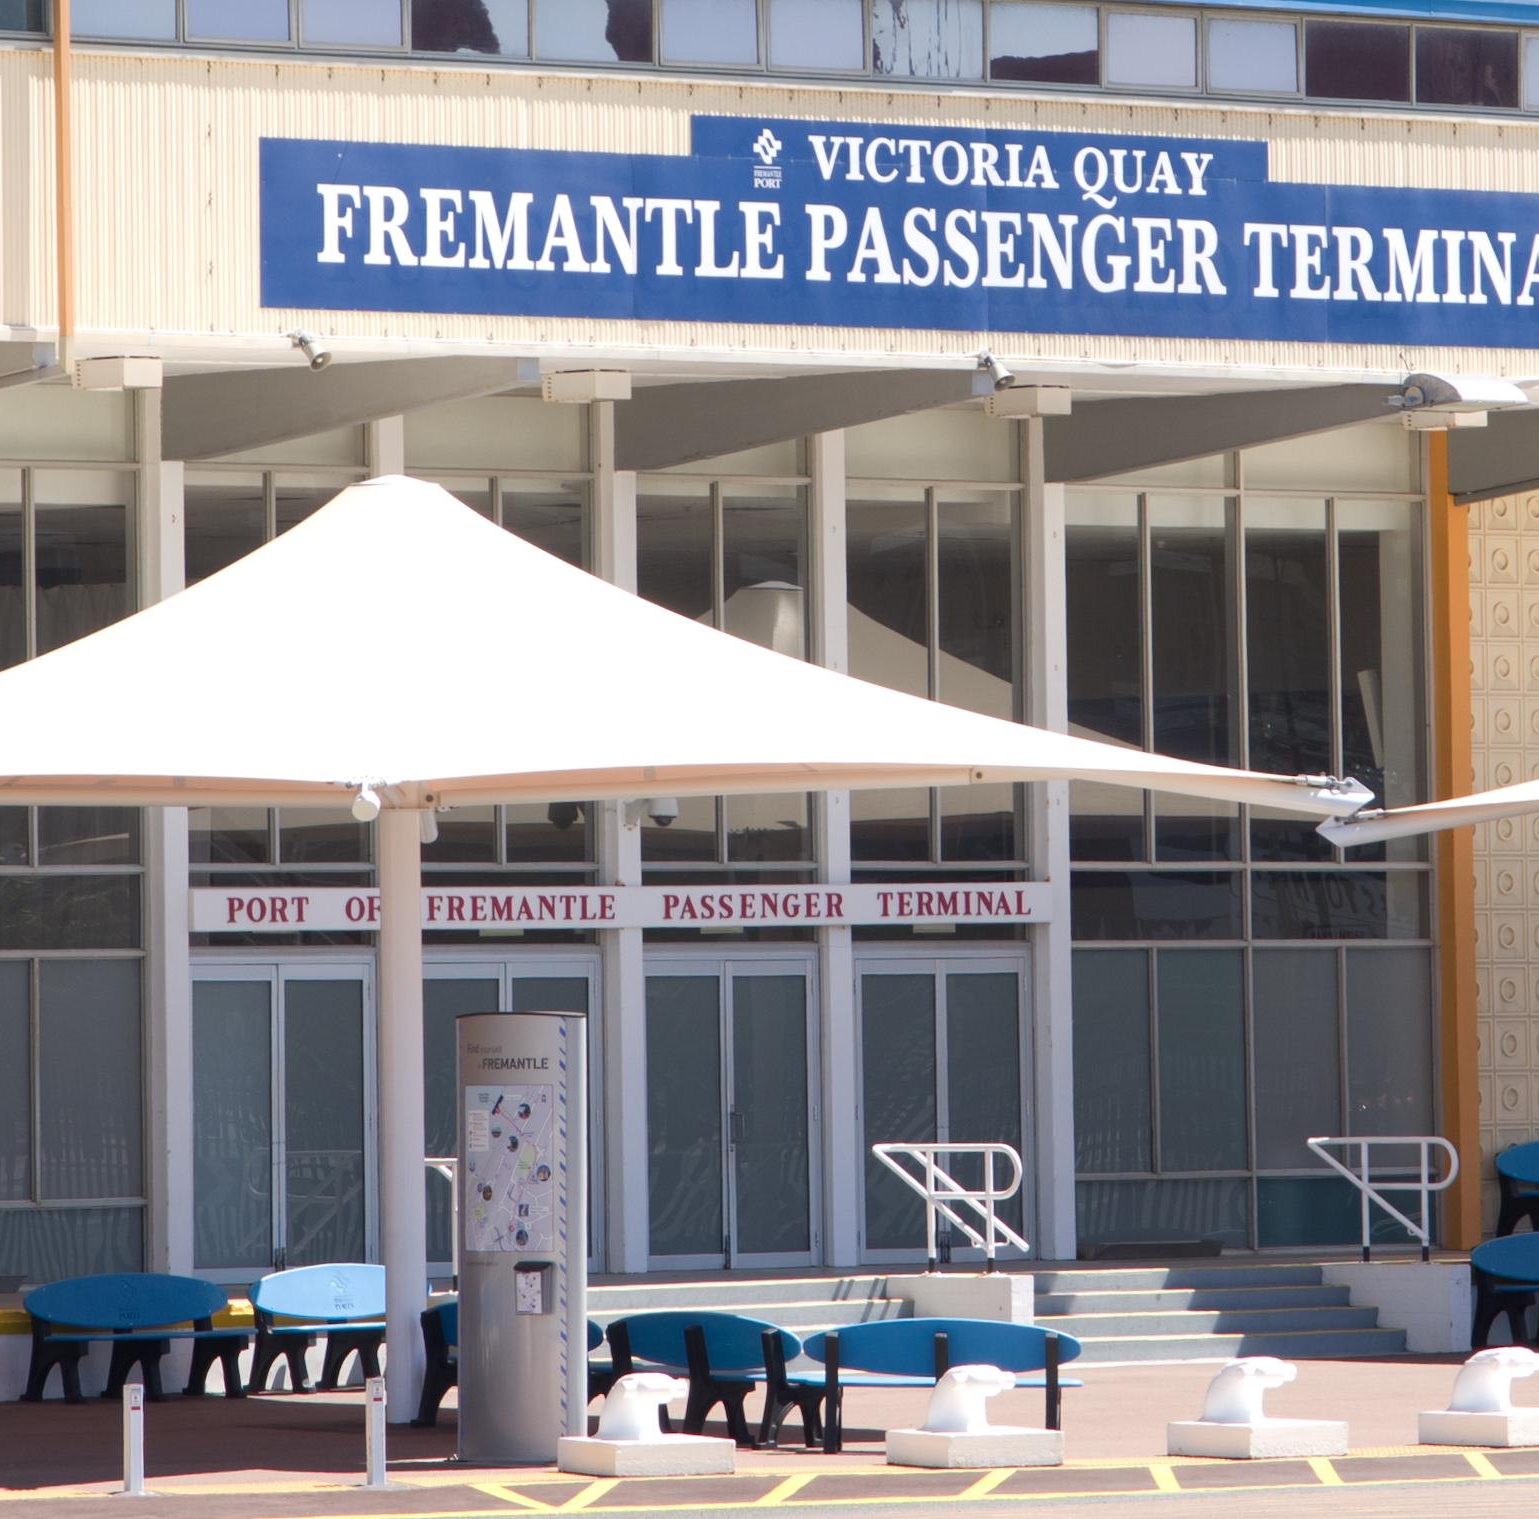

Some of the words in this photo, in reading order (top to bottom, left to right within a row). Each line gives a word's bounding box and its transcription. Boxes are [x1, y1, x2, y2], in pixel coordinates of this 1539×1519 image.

[753, 178, 782, 189] PORT
[808, 135, 1060, 189] VICTORIA
[1073, 146, 1214, 210] QUAY
[316, 183, 784, 279] FREMANTLE
[805, 204, 1227, 295] PASSENGER
[225, 896, 310, 923] PORT
[345, 895, 381, 922] OF
[426, 894, 616, 922] FREMANTLE
[662, 892, 844, 920] PASSENGER
[877, 890, 1032, 917] TERMINAL
[481, 1057, 549, 1070] FREMANTLE
